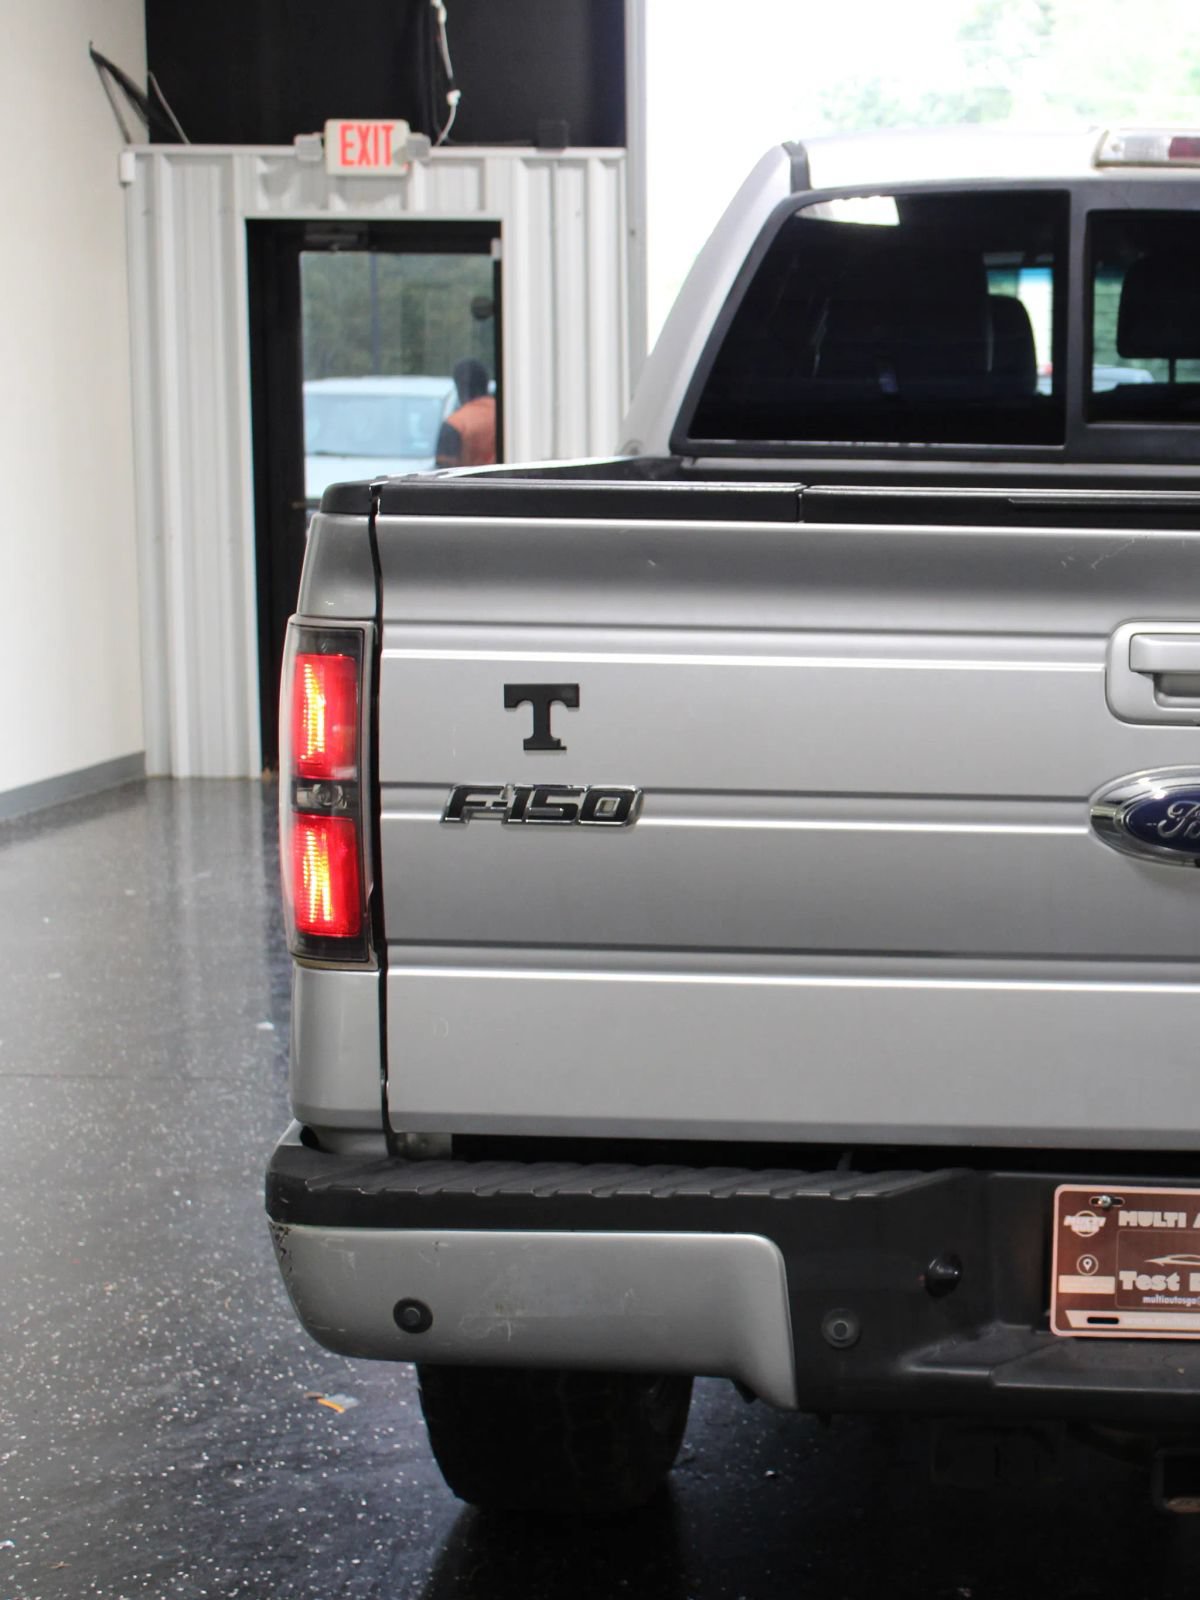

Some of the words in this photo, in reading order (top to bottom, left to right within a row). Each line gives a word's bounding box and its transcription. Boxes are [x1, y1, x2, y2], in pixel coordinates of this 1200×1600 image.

[339, 123, 395, 167] EXIT
[504, 683, 580, 751] T
[440, 783, 645, 827] F-150
[1117, 1210, 1187, 1229] MULTI
[1118, 1271, 1180, 1292] Test
